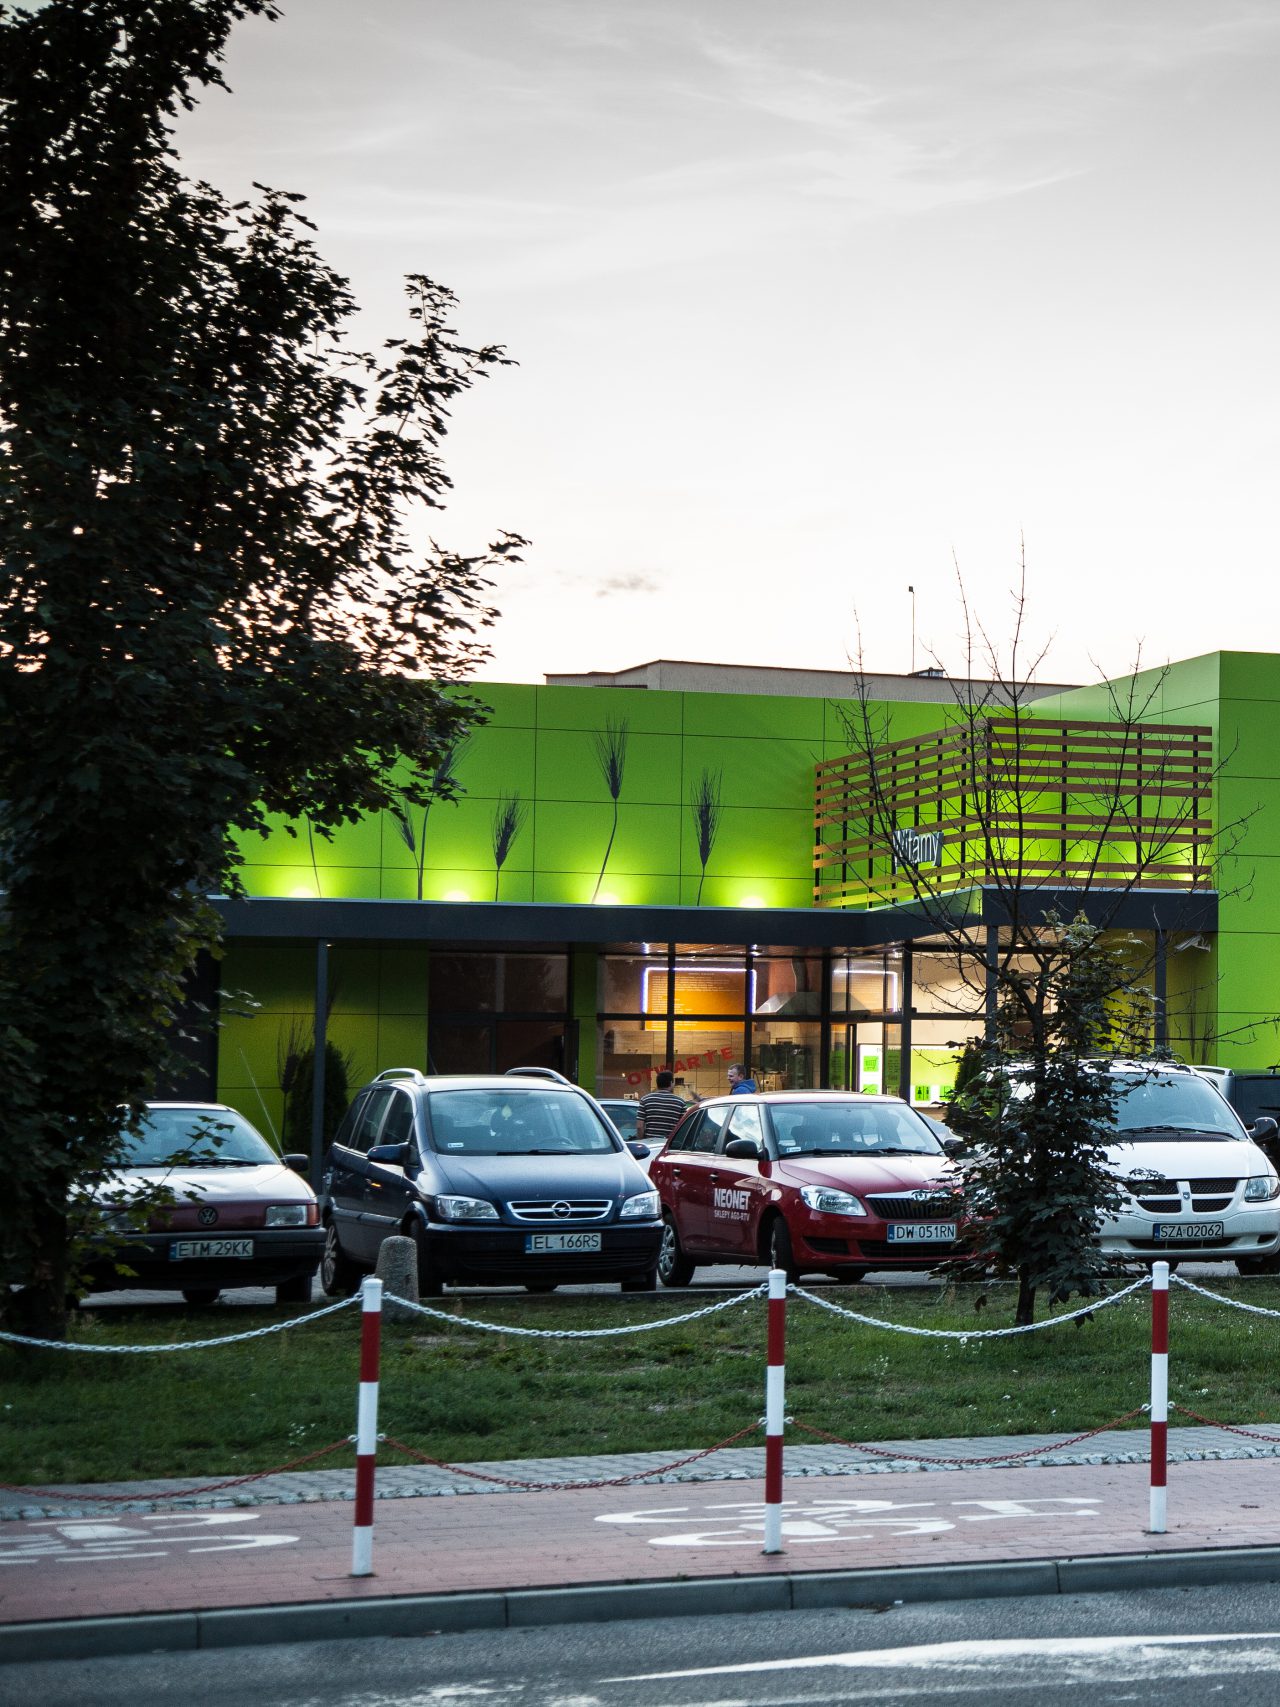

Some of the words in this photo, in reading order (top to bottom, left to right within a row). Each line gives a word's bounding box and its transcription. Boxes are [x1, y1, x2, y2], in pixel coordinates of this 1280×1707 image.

[714, 1188, 751, 1210] NEONET
[896, 1225, 915, 1239] DW
[918, 1225, 955, 1239] 051RN
[1160, 1225, 1183, 1238] SZA
[1186, 1224, 1221, 1238] 02062
[178, 1242, 211, 1257] ETM
[214, 1241, 252, 1256] 29KK
[533, 1235, 554, 1250] EL
[559, 1234, 600, 1249] 166RS
